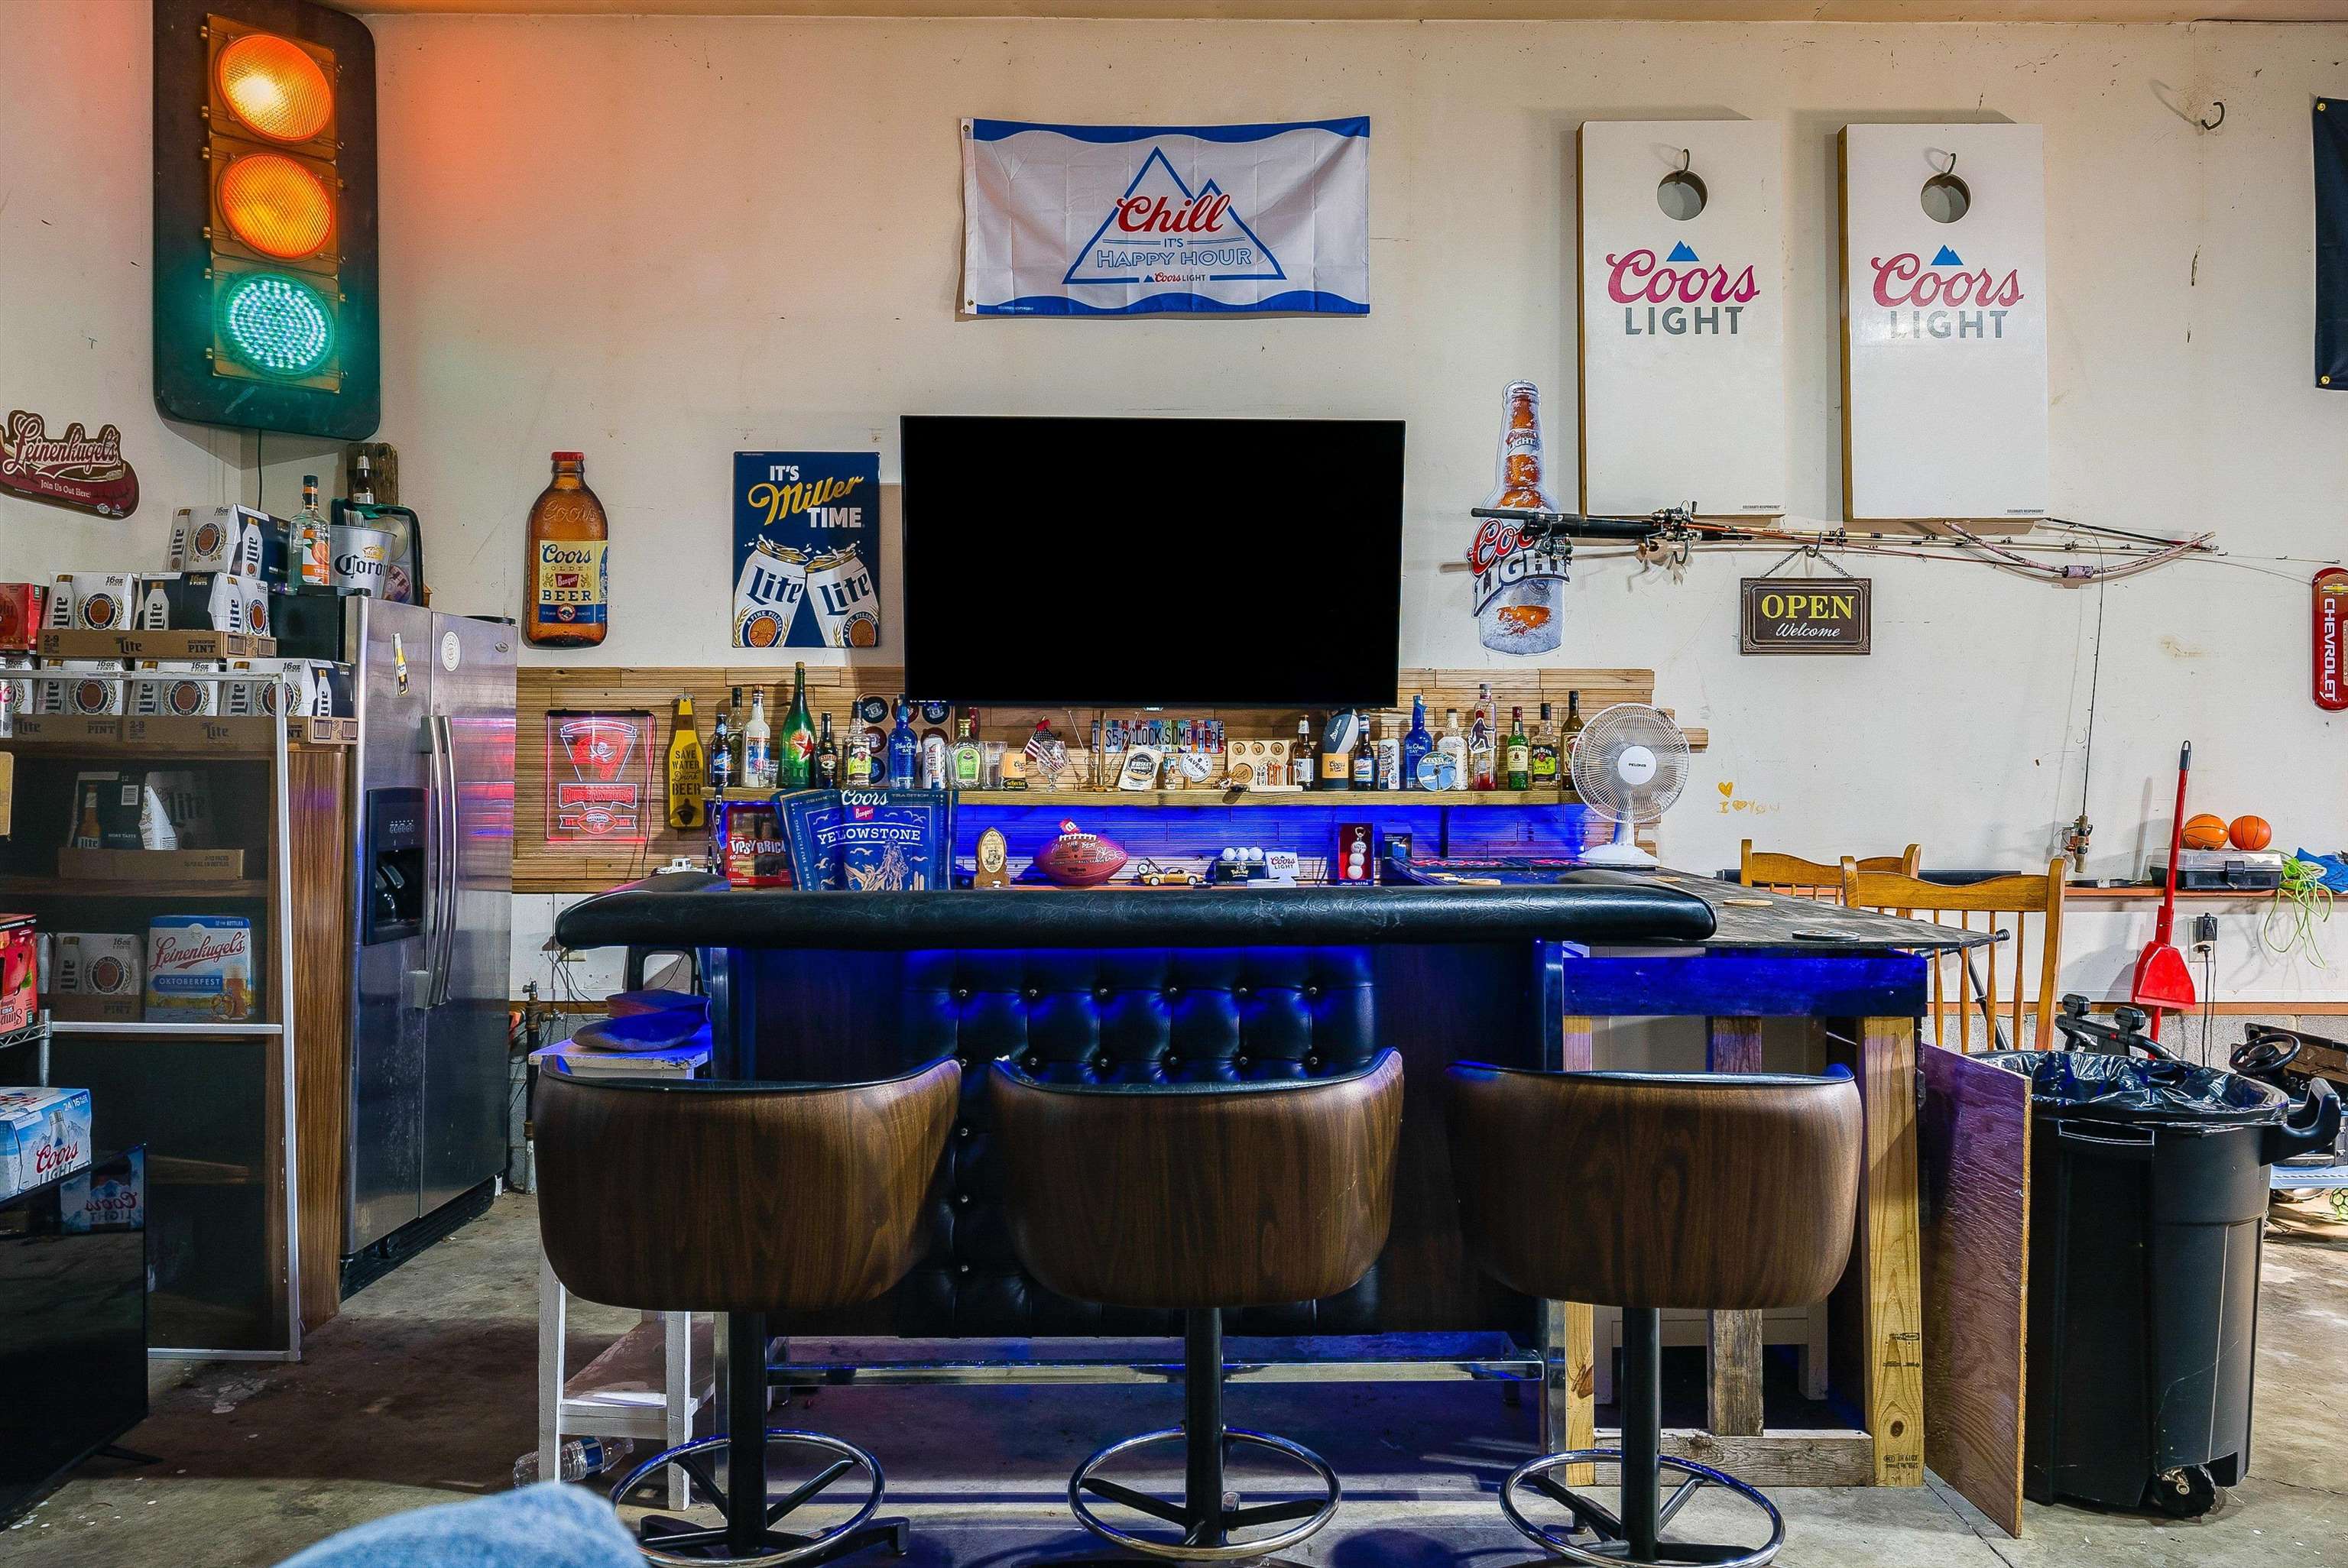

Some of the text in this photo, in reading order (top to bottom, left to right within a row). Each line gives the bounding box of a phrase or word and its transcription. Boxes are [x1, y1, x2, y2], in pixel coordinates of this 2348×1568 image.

[1117, 194, 1231, 232] Chill
[1163, 238, 1183, 248] IT'S
[1097, 248, 1252, 268] HAPPY HOUR
[1155, 272, 1206, 282] Coors LIGHT
[1606, 248, 1760, 303] Coors
[1870, 253, 2024, 307] Coors
[1626, 306, 1744, 335] LIGHT
[1890, 310, 2008, 339] LIGHT
[2, 413, 120, 477] Leinenkugel's
[770, 465, 799, 481] IT'S
[41, 479, 54, 490] Join
[54, 483, 63, 493] Us
[63, 484, 75, 495] Out
[748, 476, 864, 526] Miller
[543, 500, 598, 523] Coors
[807, 507, 862, 528] TIME
[171, 529, 185, 556] Lite
[246, 536, 259, 564] Lite
[542, 544, 592, 564] Coors
[105, 575, 123, 584] 16oz
[557, 575, 578, 587] Banquet
[746, 565, 805, 606] Lite
[542, 590, 592, 601] BEER
[817, 572, 872, 616] Lite
[53, 597, 71, 628] Lite
[149, 603, 165, 630] Lite
[230, 599, 242, 629] Lite
[1761, 594, 1855, 619] OPEN
[750, 611, 767, 622] FINE
[767, 611, 783, 633] PILSNER
[845, 617, 855, 633] FINE
[1776, 623, 1840, 637] Welcome
[119, 637, 142, 654] Lite
[187, 645, 216, 653] PINT
[2324, 598, 2336, 701] CHEVROLET
[46, 682, 62, 711] Lite
[139, 683, 156, 713] Lite
[231, 683, 248, 714] Lite
[320, 690, 330, 717] Lite
[88, 726, 115, 734] PINT
[207, 724, 229, 740] Lite
[287, 730, 303, 738] NT
[672, 760, 699, 769] WATER
[675, 750, 696, 759] SAVE
[1185, 754, 1207, 774] TAVERN
[672, 769, 700, 782] Drink
[563, 787, 634, 802] BUCCANEERS
[672, 783, 701, 795] BEER
[842, 790, 889, 805] Coors
[855, 808, 874, 819] Banquet
[81, 838, 98, 848] Lite
[817, 828, 921, 845] YELLOWSTONE
[729, 841, 757, 854] TIPSY
[1271, 857, 1296, 865] Coors
[149, 931, 245, 971] Leinenkugel's
[61, 960, 78, 991] Lite
[63, 1099, 80, 1111] 24 16
[37, 1142, 79, 1174] Coors
[40, 1161, 74, 1184] LIGHT
